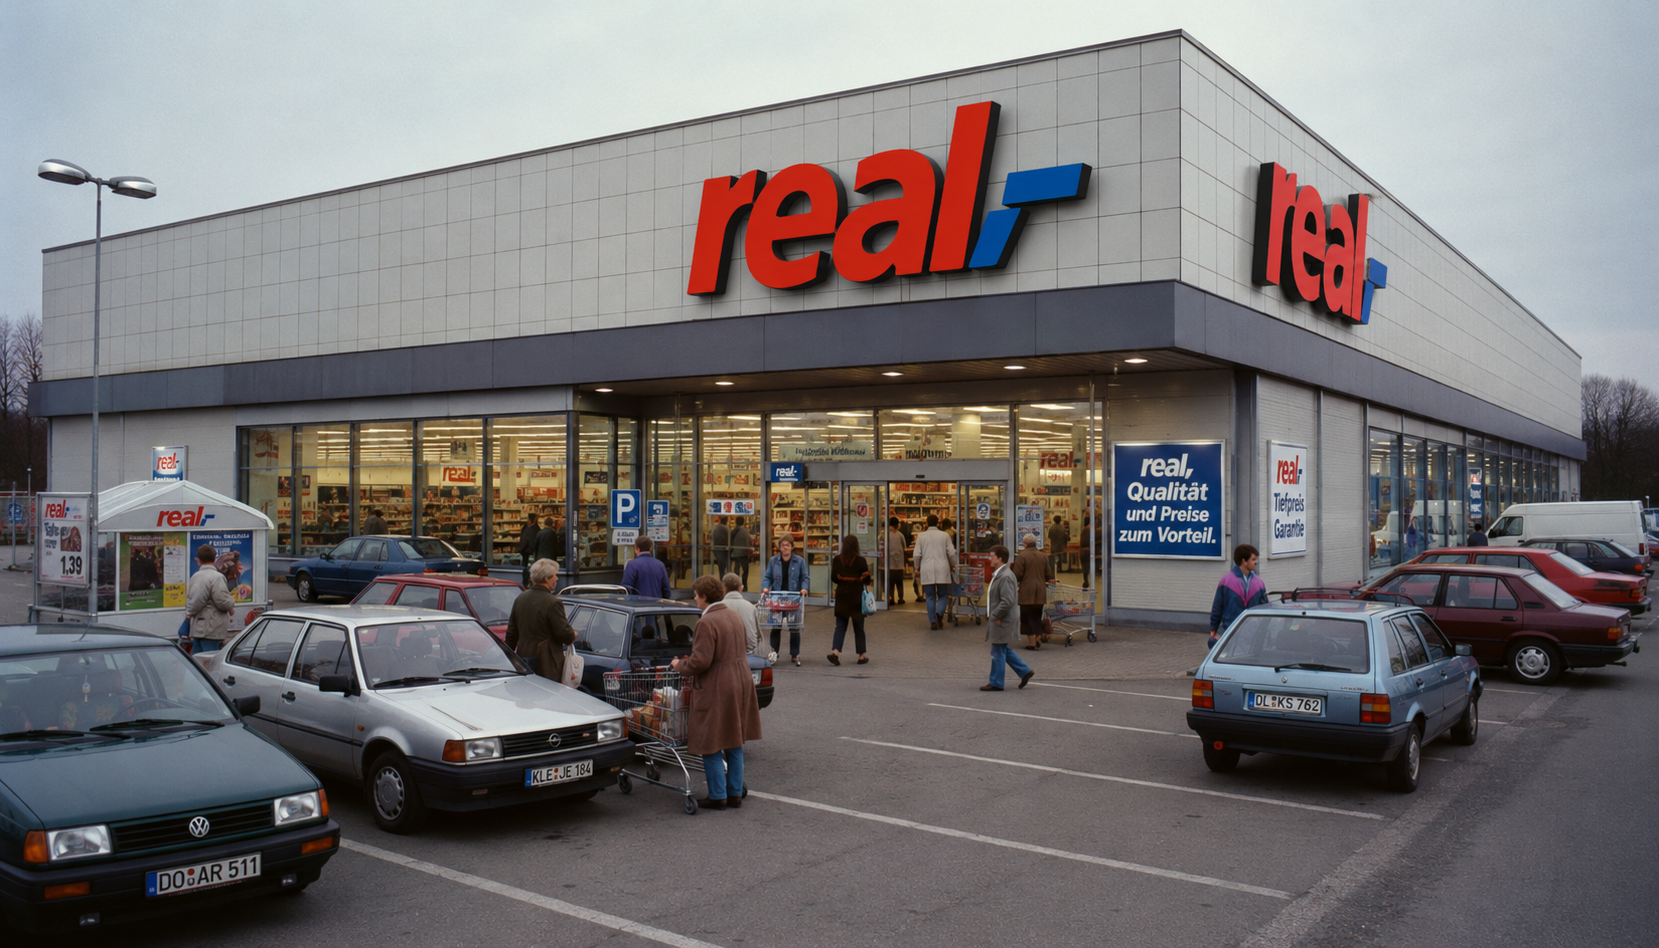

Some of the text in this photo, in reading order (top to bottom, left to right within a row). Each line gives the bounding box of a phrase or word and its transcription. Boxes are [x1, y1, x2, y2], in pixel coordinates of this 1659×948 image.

[1127, 482, 1209, 502] Qualität
[617, 493, 635, 523] P
[1126, 505, 1210, 522] und Preise
[1274, 492, 1304, 517] Tiefpreis
[1119, 526, 1216, 544] zum Vorteil.
[1274, 519, 1304, 539] Garantie
[1255, 694, 1320, 712] DL KS 762
[532, 762, 591, 783] KLE JE 184
[159, 870, 185, 893] DO
[197, 863, 223, 885] AR
[229, 856, 257, 879] 511
